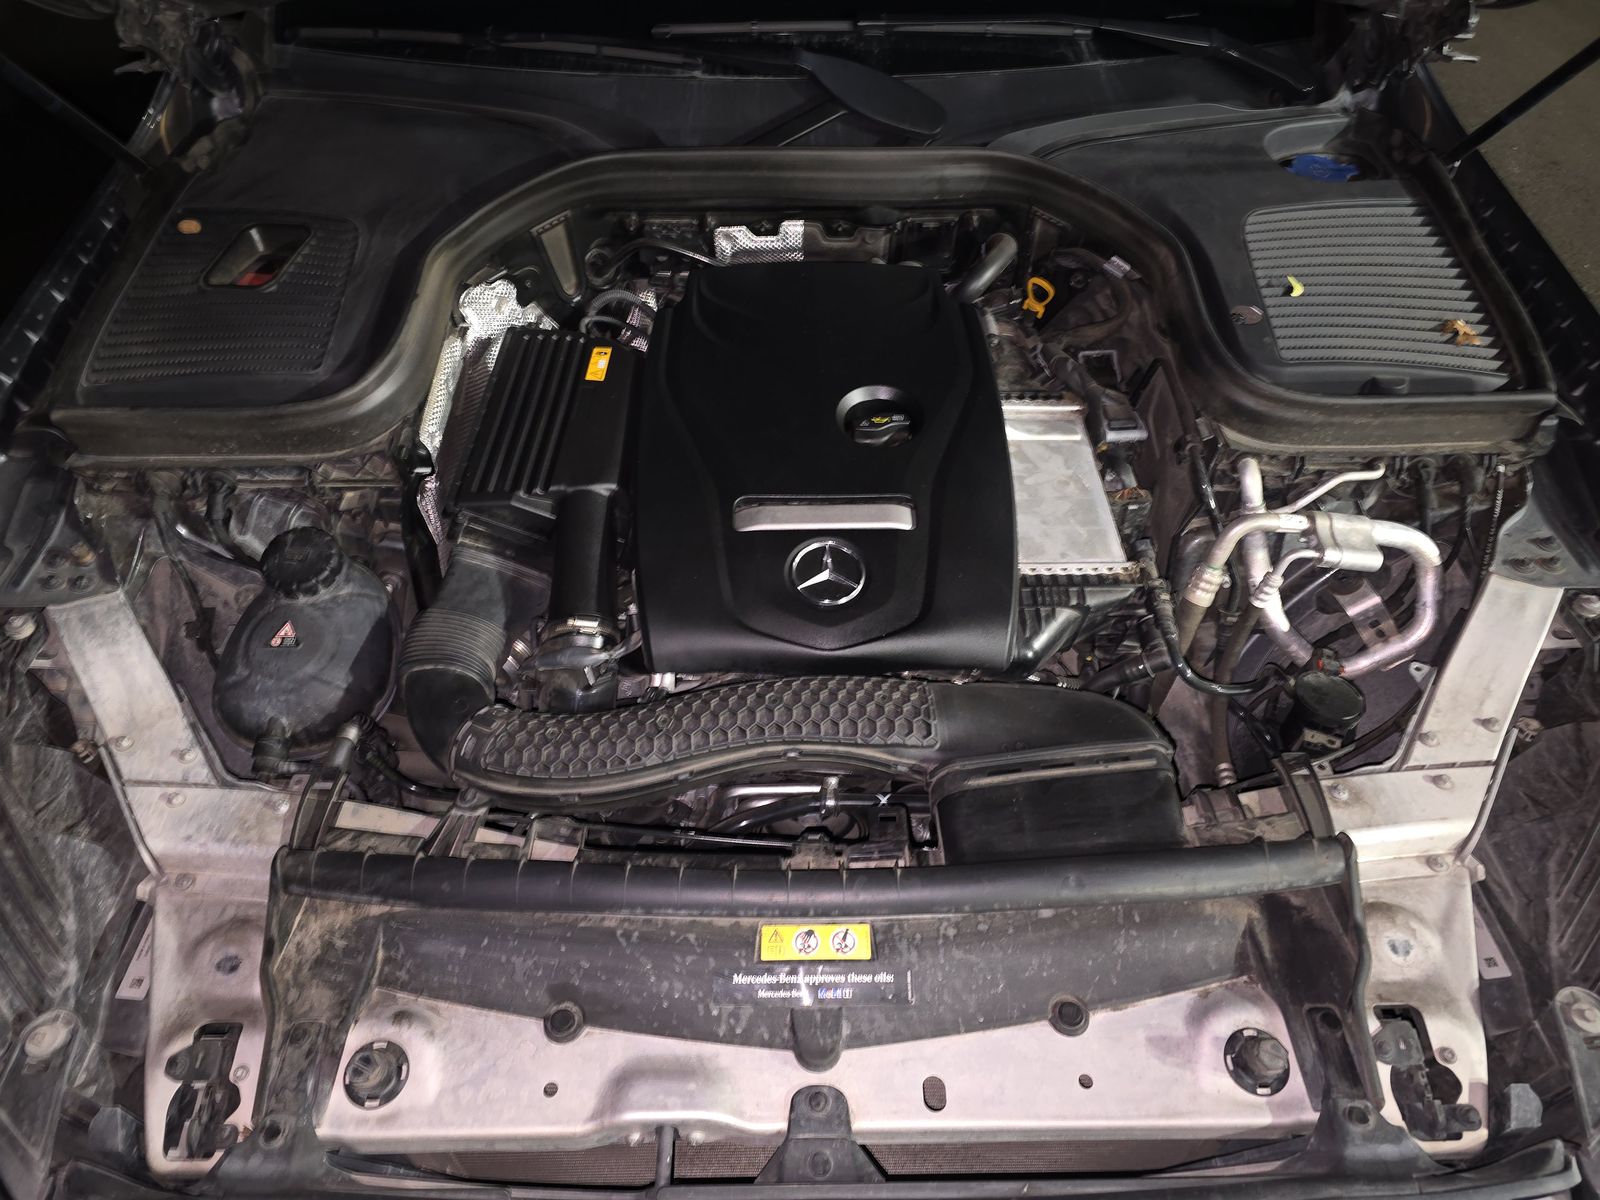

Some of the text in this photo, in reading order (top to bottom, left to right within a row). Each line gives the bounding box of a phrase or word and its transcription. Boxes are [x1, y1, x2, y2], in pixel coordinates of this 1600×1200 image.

[732, 972, 894, 986] Mercedes-Benz approves these oils:
[757, 988, 809, 999] Mercedes-Be
